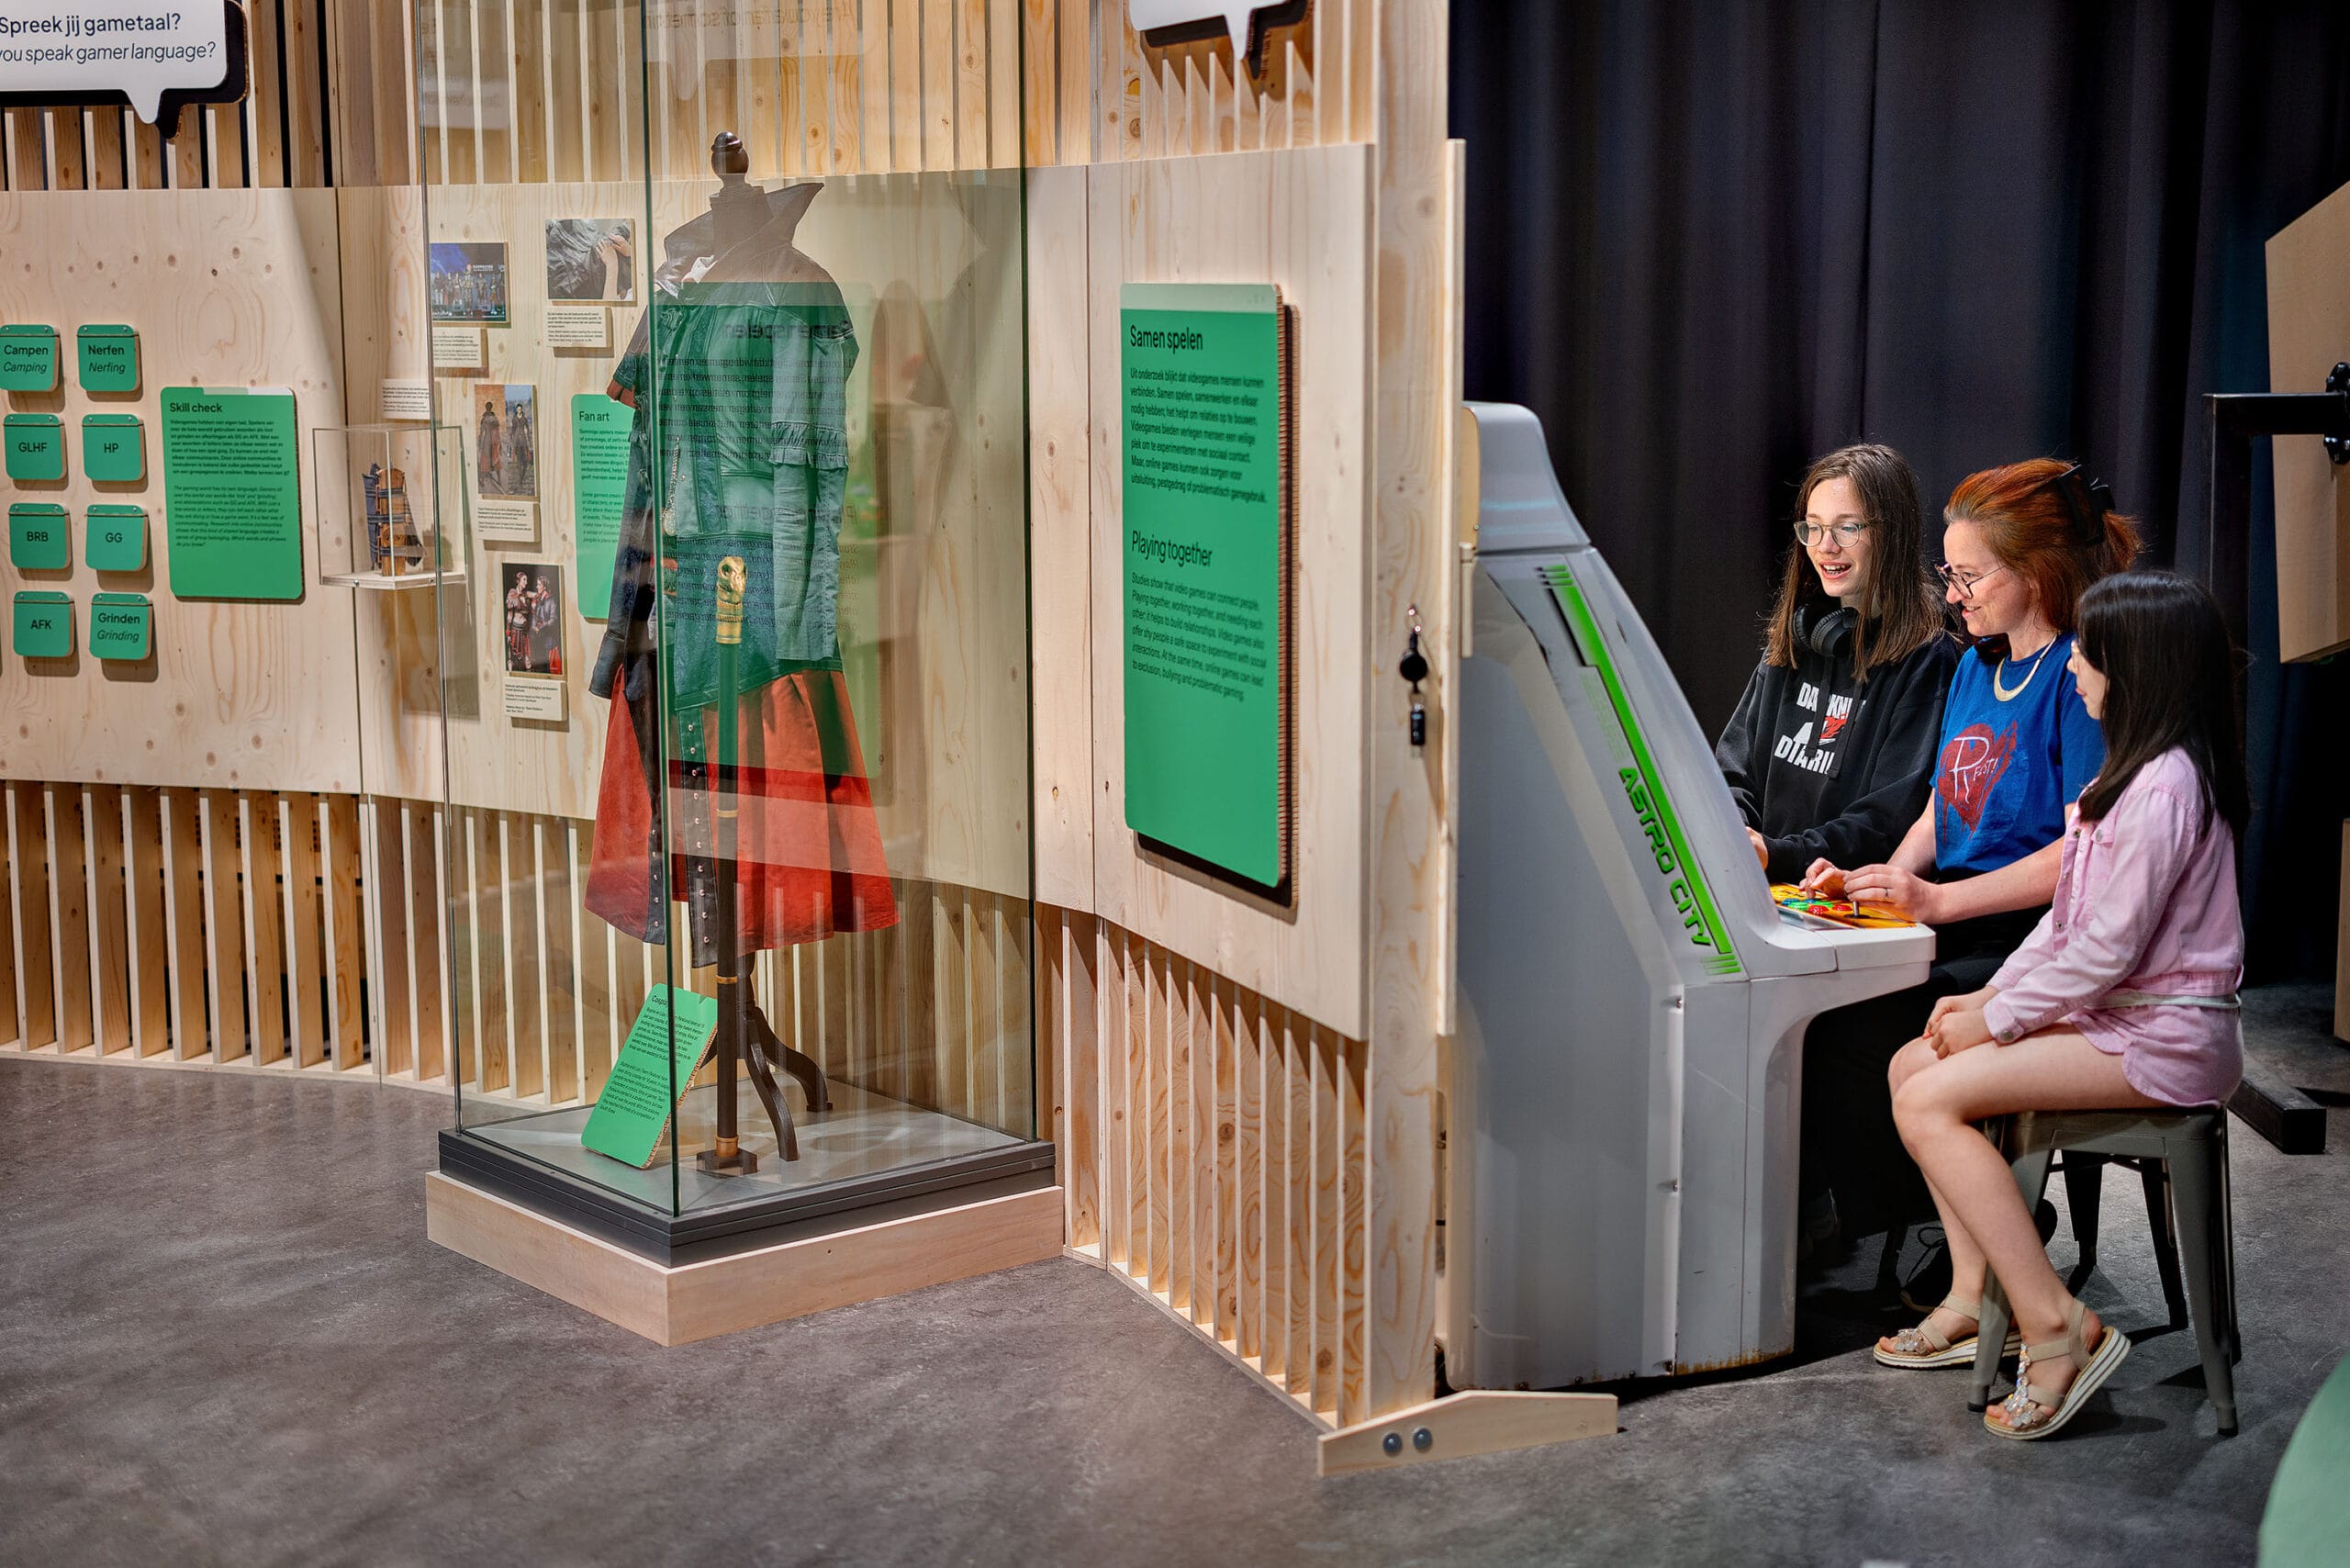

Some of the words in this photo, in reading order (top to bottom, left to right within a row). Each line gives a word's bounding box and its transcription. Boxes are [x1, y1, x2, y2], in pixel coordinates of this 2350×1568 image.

[0, 16, 62, 38] Spreek
[65, 16, 80, 37] jij
[84, 13, 181, 36] gametaal?
[26, 44, 73, 65] speak
[77, 47, 129, 64] gamer
[131, 41, 216, 63] language?
[1130, 324, 1165, 348] Samen
[1167, 327, 1203, 354] spelen
[4, 344, 49, 364] Campen
[88, 344, 125, 356] Nerfen
[3, 362, 48, 375] Camping
[88, 362, 126, 375] Nerfing
[170, 402, 190, 413] Skill
[192, 403, 222, 413] check
[579, 411, 595, 421] Fan
[597, 412, 610, 421] art
[18, 442, 48, 453] GLHF
[104, 442, 119, 454] HP
[27, 532, 49, 543] BRB
[105, 532, 123, 543] GG
[1132, 531, 1166, 563] Playing
[1168, 541, 1213, 567] together
[30, 619, 51, 630] AFK
[98, 612, 140, 625] Grinden
[96, 630, 140, 644] Grinding
[1796, 681, 1867, 721] DAKN
[1774, 734, 1836, 775] DIARI
[1618, 768, 1676, 875] ASTRO
[1670, 878, 1712, 946] CITY
